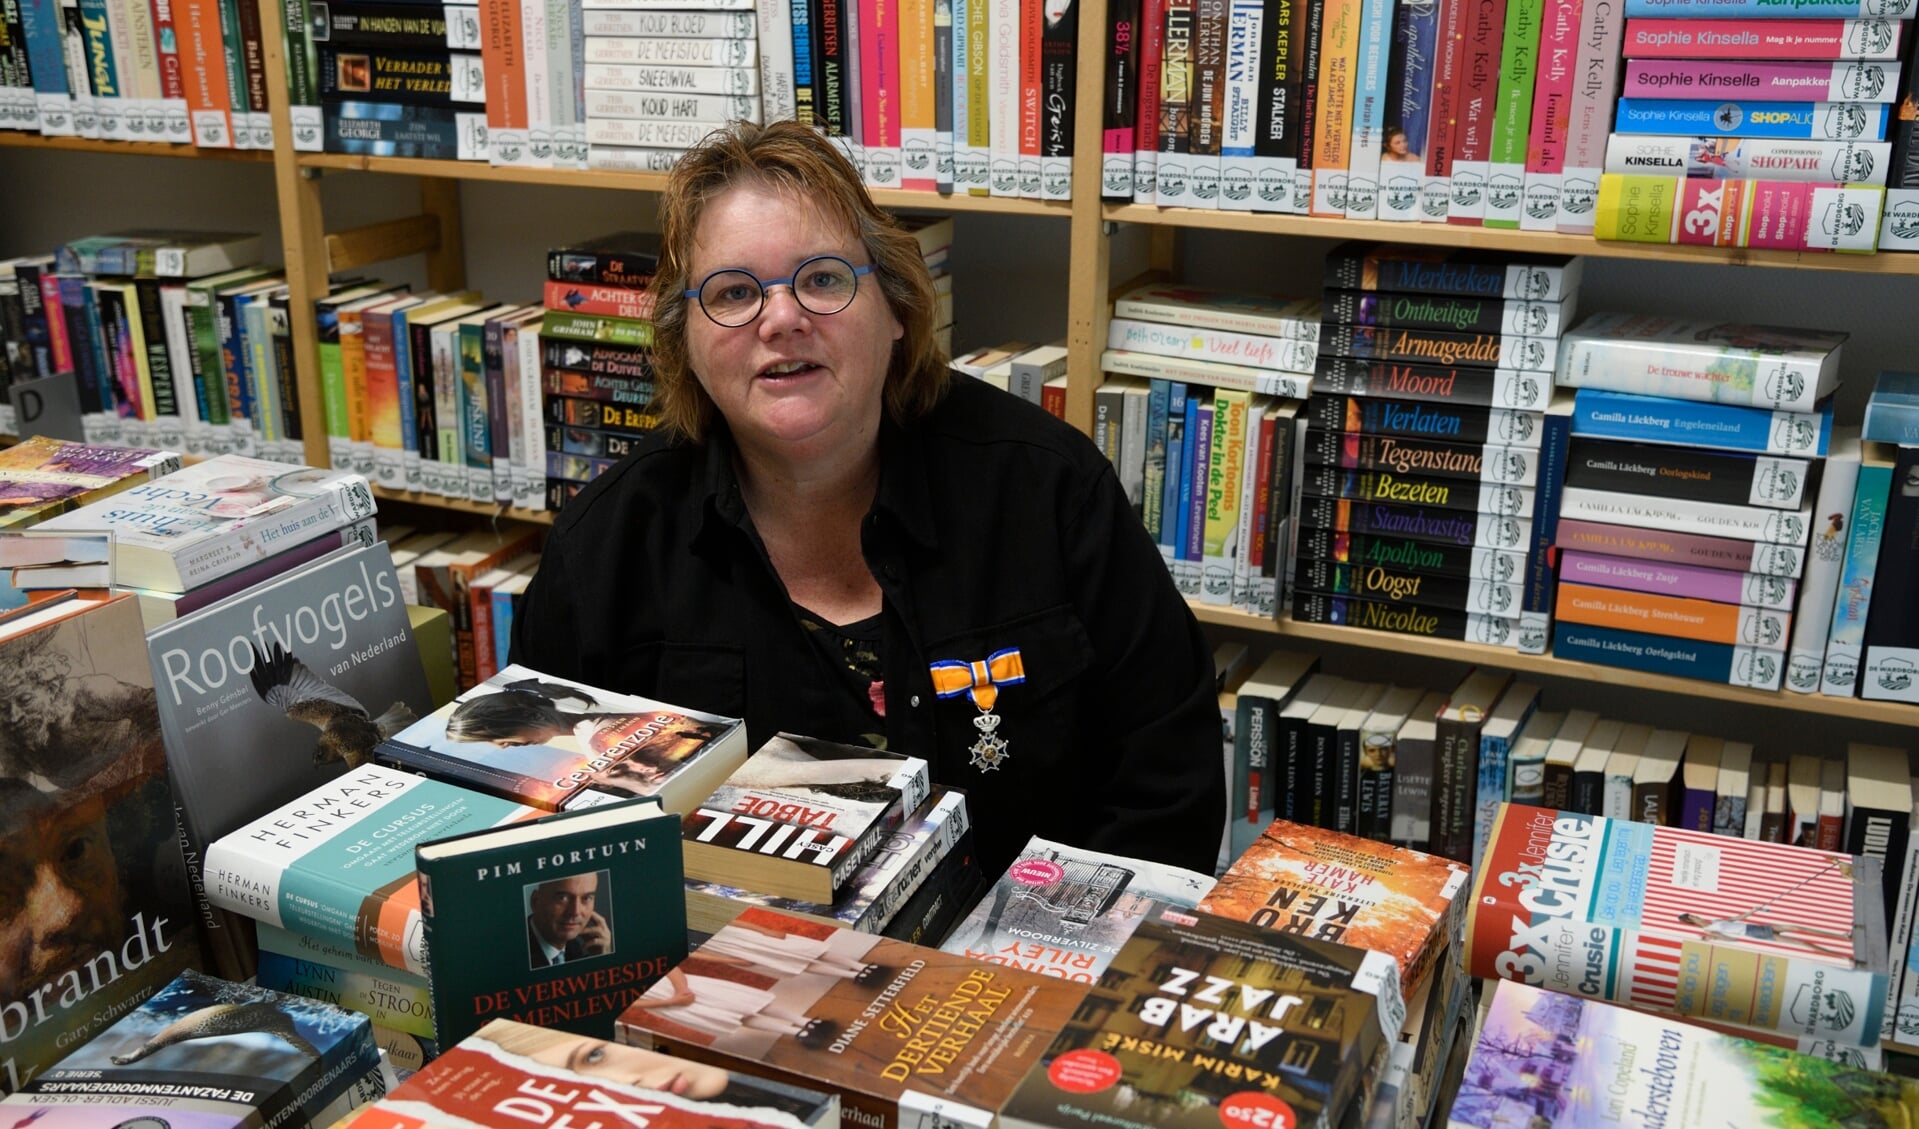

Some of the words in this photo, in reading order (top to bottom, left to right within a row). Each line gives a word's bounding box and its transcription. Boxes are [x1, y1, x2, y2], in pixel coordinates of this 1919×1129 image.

[360, 17, 369, 31] IN
[369, 17, 401, 33] HANDEN
[402, 18, 419, 33] VAN
[420, 18, 431, 34] DE
[640, 17, 667, 34] KOUD
[671, 17, 705, 34] BLOED
[1551, 4, 1572, 43] Cathy
[1588, 2, 1611, 51] Cathy
[1636, 31, 1692, 46] Sophie
[1697, 31, 1760, 45] Kinsella
[1766, 35, 1784, 44] Mag
[1804, 36, 1837, 44] nummer
[375, 56, 441, 74] VERRADER
[638, 42, 653, 60] DE
[656, 41, 700, 60] MEFISTO
[972, 31, 983, 75] GIBSON
[1275, 31, 1288, 80] KEPLER
[1508, 46, 1529, 84] Kelly
[1547, 49, 1567, 82] Kelly
[639, 70, 697, 88] SNEEUWVAL
[1203, 71, 1213, 81] DE
[1366, 45, 1379, 90] BEGINNERS
[1467, 52, 1489, 91] Kelly
[1584, 58, 1605, 100] Kelly
[1637, 72, 1693, 87] Sophie
[1698, 73, 1760, 87] Kinsella
[375, 78, 401, 90] HET
[825, 62, 840, 121] ALARMFASE
[1201, 83, 1213, 102] JUNI
[1512, 89, 1520, 99] Ik
[641, 99, 668, 115] KOUD
[672, 99, 698, 117] HART
[1025, 88, 1037, 147] SWITCH
[1230, 86, 1240, 141] STRAIGHT
[1239, 98, 1249, 132] BILLY
[1270, 88, 1285, 139] STALKER
[1363, 96, 1374, 122] Marian
[1467, 98, 1482, 122] Wat
[1507, 101, 1517, 125] moet
[1543, 93, 1562, 143] Iemand
[1582, 105, 1595, 130] Eens
[1628, 109, 1666, 123] Sophie
[1668, 110, 1710, 122] Kinsella
[338, 128, 382, 139] GEORGE
[1200, 105, 1212, 144] MOORDEN
[1361, 125, 1372, 148] Keyes
[1466, 126, 1478, 146] wil
[1540, 148, 1555, 166] als
[1625, 157, 1683, 167] KINSELLA
[1622, 186, 1641, 236] Sophie
[1644, 184, 1664, 236] Kinsella
[1685, 187, 1723, 236] 3x
[1833, 193, 1845, 230] WARDBORG
[1832, 232, 1839, 245] DE
[610, 261, 623, 272] DE
[591, 290, 636, 304] ACHTER
[1394, 299, 1481, 329] Ontheiligd
[553, 326, 595, 337] GRISHAM
[607, 361, 642, 376] DUIVEL
[1386, 366, 1457, 396] Moord
[1647, 364, 1660, 375] De
[1662, 367, 1693, 378] trouwe
[19, 390, 44, 423] D
[603, 406, 622, 425] DE
[1230, 401, 1245, 438] Toon
[1382, 404, 1461, 434] Verlaten
[1591, 411, 1626, 423] Camilla
[1628, 412, 1670, 428] Läckberg
[1674, 419, 1741, 433] Engeleneiland
[1200, 419, 1209, 441] Kees
[1213, 399, 1229, 448] Dokter
[608, 438, 629, 454] DE
[1197, 443, 1206, 461] van
[1213, 452, 1226, 465] in
[1195, 462, 1206, 496] Kooten
[1211, 468, 1224, 485] de
[1224, 440, 1243, 511] Kortooms
[1586, 459, 1618, 471] Camilla
[1619, 462, 1656, 476] Läckberg
[1208, 489, 1222, 520] Peel
[1375, 474, 1449, 504] Bezeten
[260, 528, 279, 544] Het
[281, 521, 301, 537] huis
[1191, 501, 1203, 554] Levensnevel
[1371, 506, 1473, 545] Standvastig
[1366, 540, 1444, 568] Apollyon
[1366, 567, 1421, 600] Oogst
[1576, 561, 1610, 575] Camilla
[1611, 565, 1654, 582] Läckberg
[1362, 602, 1439, 634] Nicolae
[1572, 598, 1607, 612] Camilla
[1608, 603, 1649, 618] Läckberg
[161, 560, 396, 706] Roofvogels
[1567, 635, 1601, 650] Camilla
[1602, 639, 1643, 656] Läckberg
[330, 659, 351, 678] van
[351, 628, 407, 666] Nederland
[553, 712, 677, 791] Gevarenzone
[1249, 707, 1264, 767] PERSSON
[1287, 731, 1299, 764] DONNA
[1315, 736, 1325, 769] DONNA
[1286, 766, 1298, 789] LEON
[1314, 772, 1325, 796] LEON
[250, 772, 382, 842] HERMAN
[1248, 786, 1260, 810] Linda
[1361, 779, 1376, 812] LEWIS
[1378, 772, 1391, 819] BEVERLY
[276, 779, 406, 850] FINKERS
[345, 840, 373, 855] DE
[372, 802, 437, 842] CURSUS
[731, 795, 838, 832] TABOE
[696, 808, 851, 867] HILL
[1527, 811, 1558, 864] Jennifer
[477, 862, 522, 880] PIM
[537, 838, 648, 870] FORTUYN
[832, 850, 862, 892] CASEY
[862, 826, 883, 860] HILL
[1021, 867, 1052, 879] NIEUW
[1304, 860, 1376, 886] HAMER
[1516, 816, 1594, 920] Crusie
[184, 851, 221, 930] Nederland
[218, 868, 271, 896] HERMAN
[218, 884, 271, 911] FINKERS
[1306, 873, 1357, 894] KATE
[1266, 886, 1361, 925] KEN
[1000, 940, 1097, 970] RILEY
[1007, 926, 1099, 953] ZILVERBOOM
[1493, 914, 1552, 984] 3x
[294, 958, 336, 983] LYNN
[1550, 924, 1576, 992] Jennifer
[1578, 927, 1606, 995] Crusie
[285, 981, 341, 1005] AUSTIN
[373, 979, 401, 994] TEGEN
[473, 991, 510, 1016] DE
[515, 956, 670, 1006] VERWEESDE
[1159, 967, 1304, 1022] JAZZ
[1806, 969, 1825, 1022] WARDBORG
[828, 1018, 868, 1056] DIANE
[861, 958, 927, 1026] SETTERFIELD
[55, 1025, 92, 1052] Gary
[880, 968, 997, 1084] DERTIENDE
[916, 986, 1014, 1079] VERHAAL
[1138, 997, 1285, 1052] ARAB
[1102, 1032, 1185, 1063] MISKÉ
[1192, 1054, 1281, 1089] KARIM
[1610, 1039, 1639, 1096] Copeland
[40, 1082, 219, 1101] FAZANTENMOORDENAARS
[225, 1090, 255, 1102] DE
[492, 1078, 582, 1128] DE
[1600, 1095, 1623, 1123] Lori
